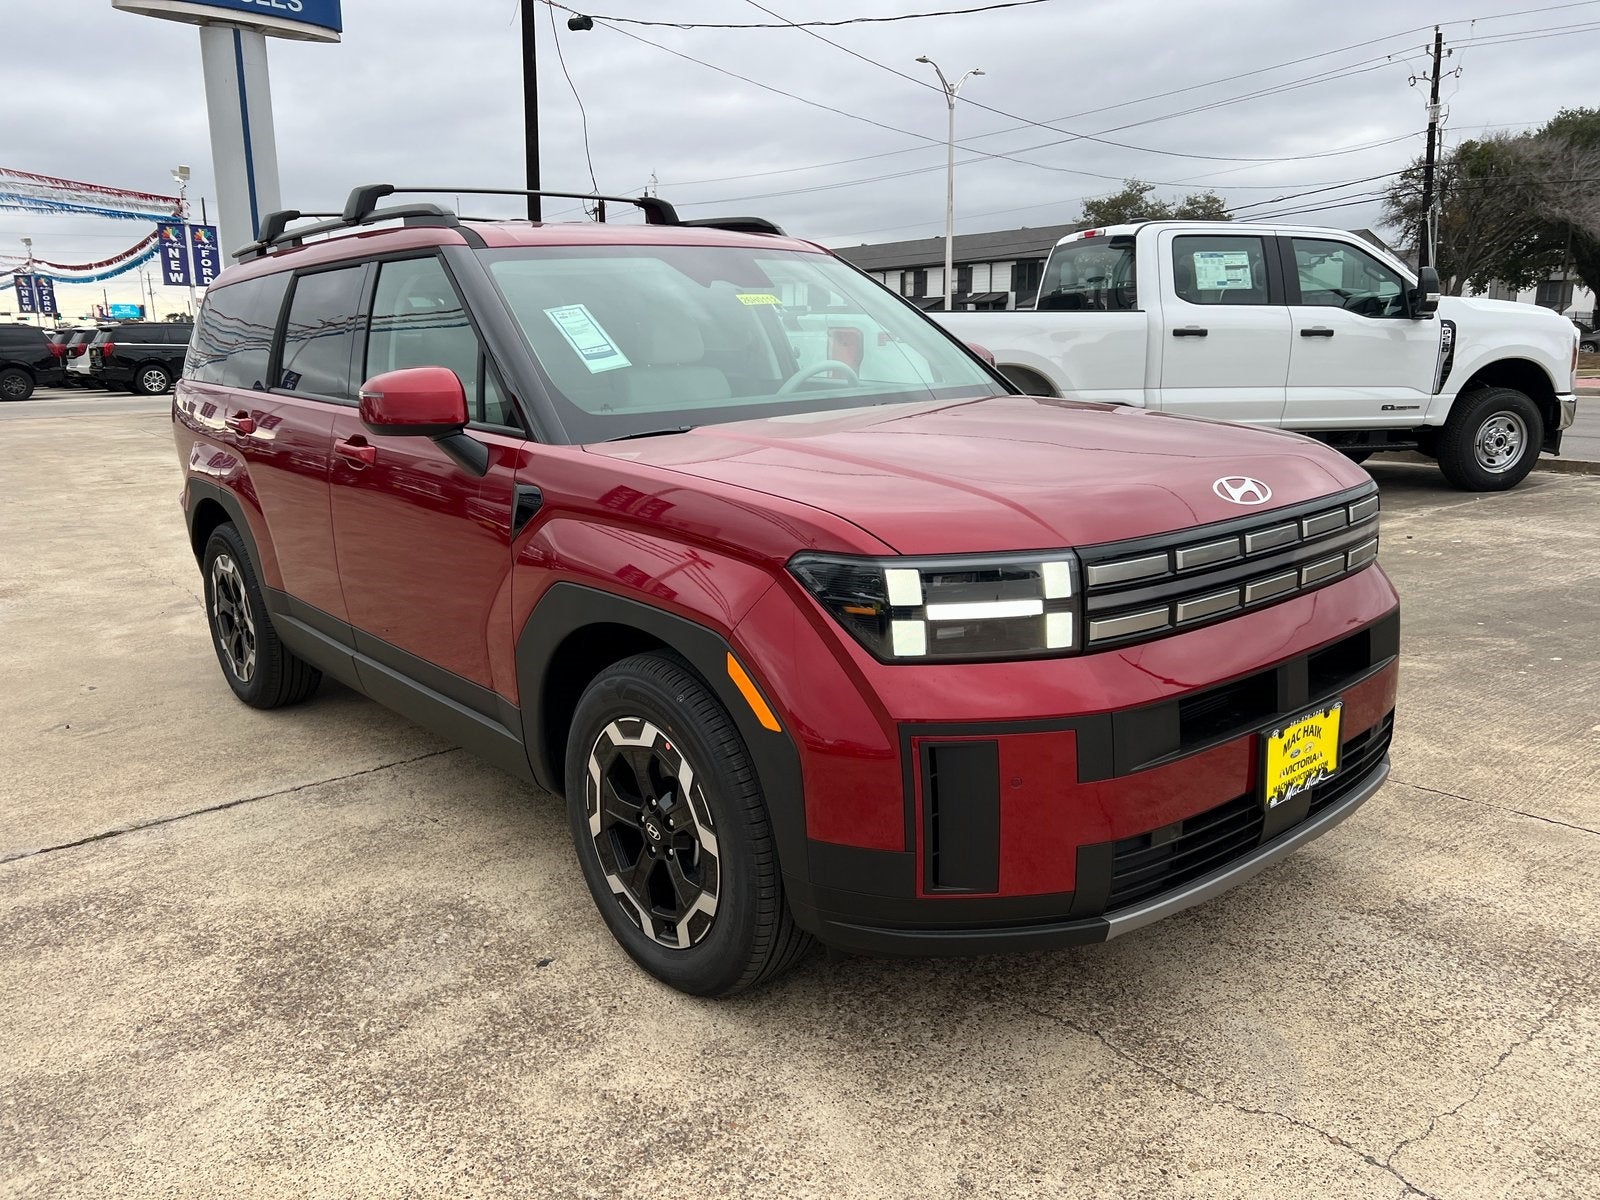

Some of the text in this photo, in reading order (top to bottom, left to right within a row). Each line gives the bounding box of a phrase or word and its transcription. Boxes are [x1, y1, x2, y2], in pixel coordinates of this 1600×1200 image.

[168, 248, 184, 283] NEW
[200, 250, 214, 285] FORD
[20, 290, 31, 311] NEW
[42, 290, 52, 312] FORD
[1283, 728, 1301, 756] MAC
[1302, 725, 1322, 739] HAIK
[1285, 753, 1317, 775] VICTORIA
